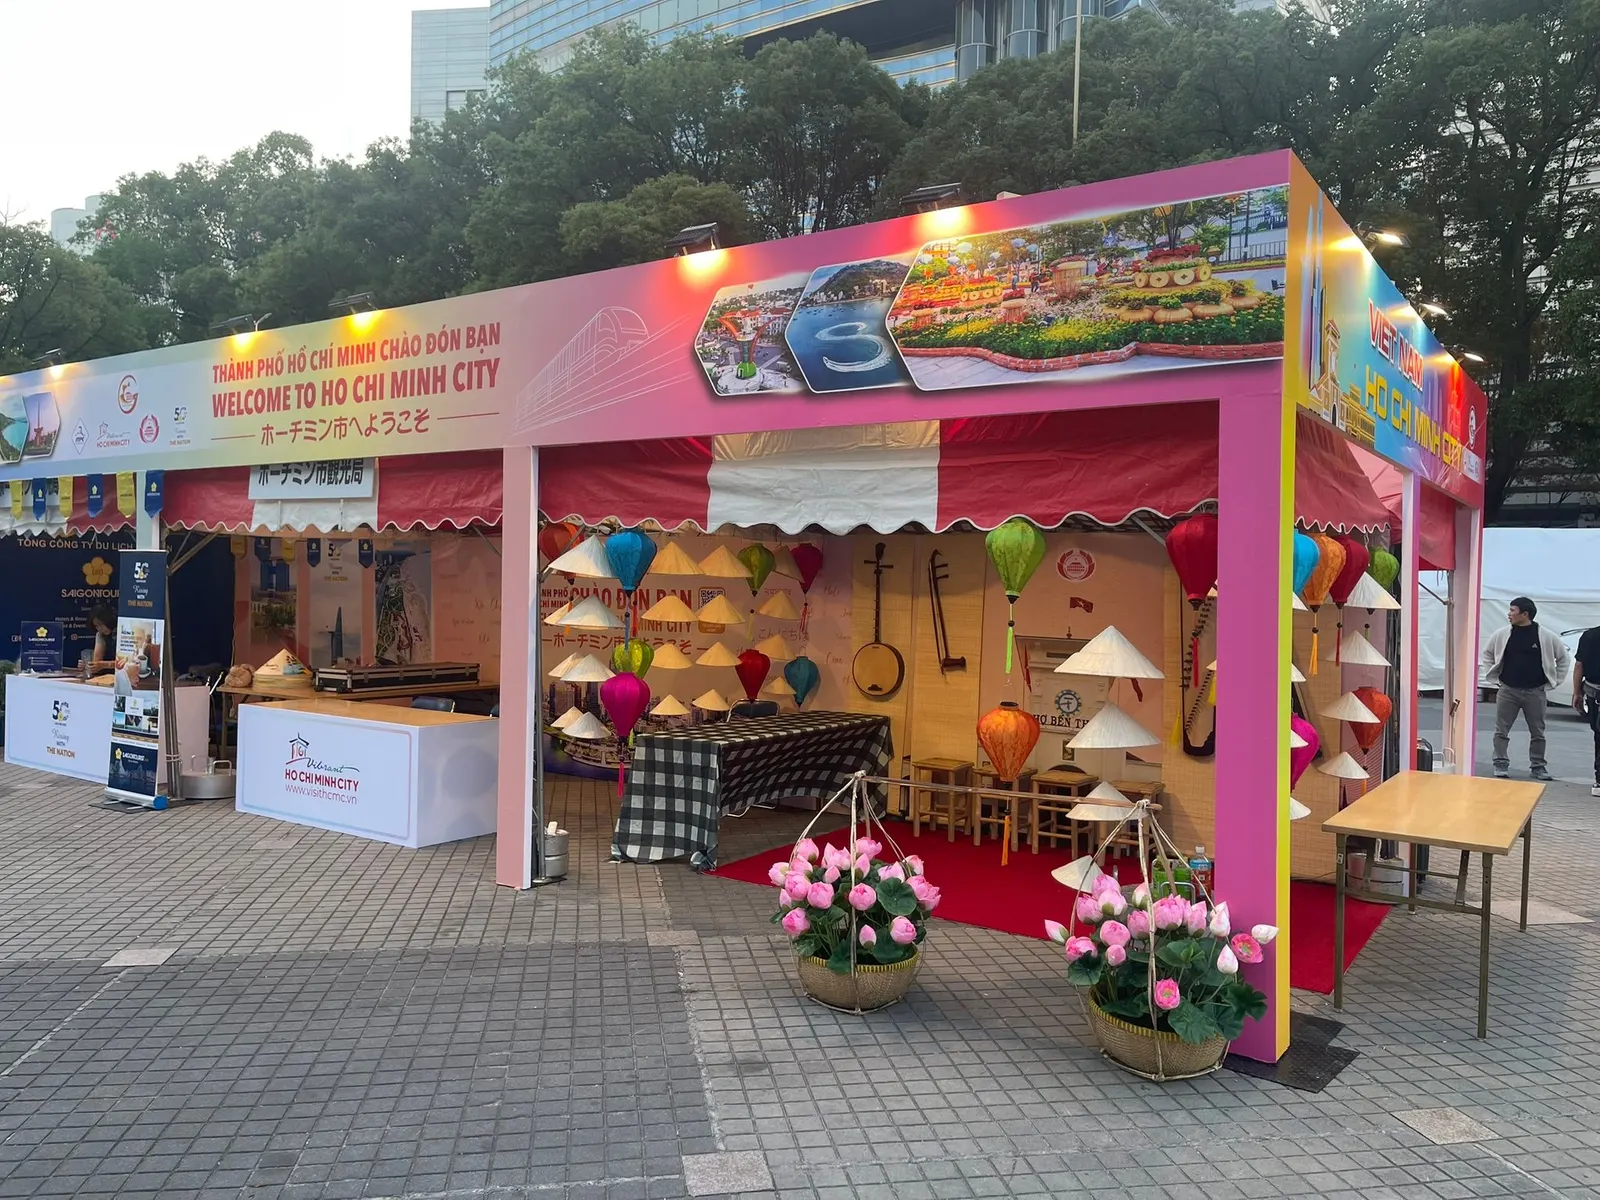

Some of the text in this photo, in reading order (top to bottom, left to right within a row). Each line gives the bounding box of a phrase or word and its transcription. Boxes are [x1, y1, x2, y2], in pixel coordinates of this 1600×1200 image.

[212, 322, 500, 384] THÀNH PHỐ HỒ CHÍ MINH CHÀO ĐÓN BẠN
[1368, 298, 1424, 392] VIET NAM
[212, 358, 500, 418] WELCOME TO HO CHI MINH CITY
[261, 408, 430, 446] ホーチミン市へようこそ
[1365, 366, 1388, 419] HO
[1391, 388, 1412, 437] CHI
[1414, 407, 1441, 456] MINH
[1442, 431, 1463, 471] CITY
[49, 538, 78, 549] CÔNG
[81, 541, 94, 549] TY
[96, 541, 109, 550] DU
[61, 588, 120, 598] SAIGONTOU
[657, 588, 692, 610] BN
[1033, 713, 1047, 726] HỢ
[56, 747, 75, 758] NATION
[306, 757, 360, 774] Vibrant
[285, 768, 359, 792] HO CHI MINH CITY
[285, 783, 358, 805] www.visithcmc.vn
